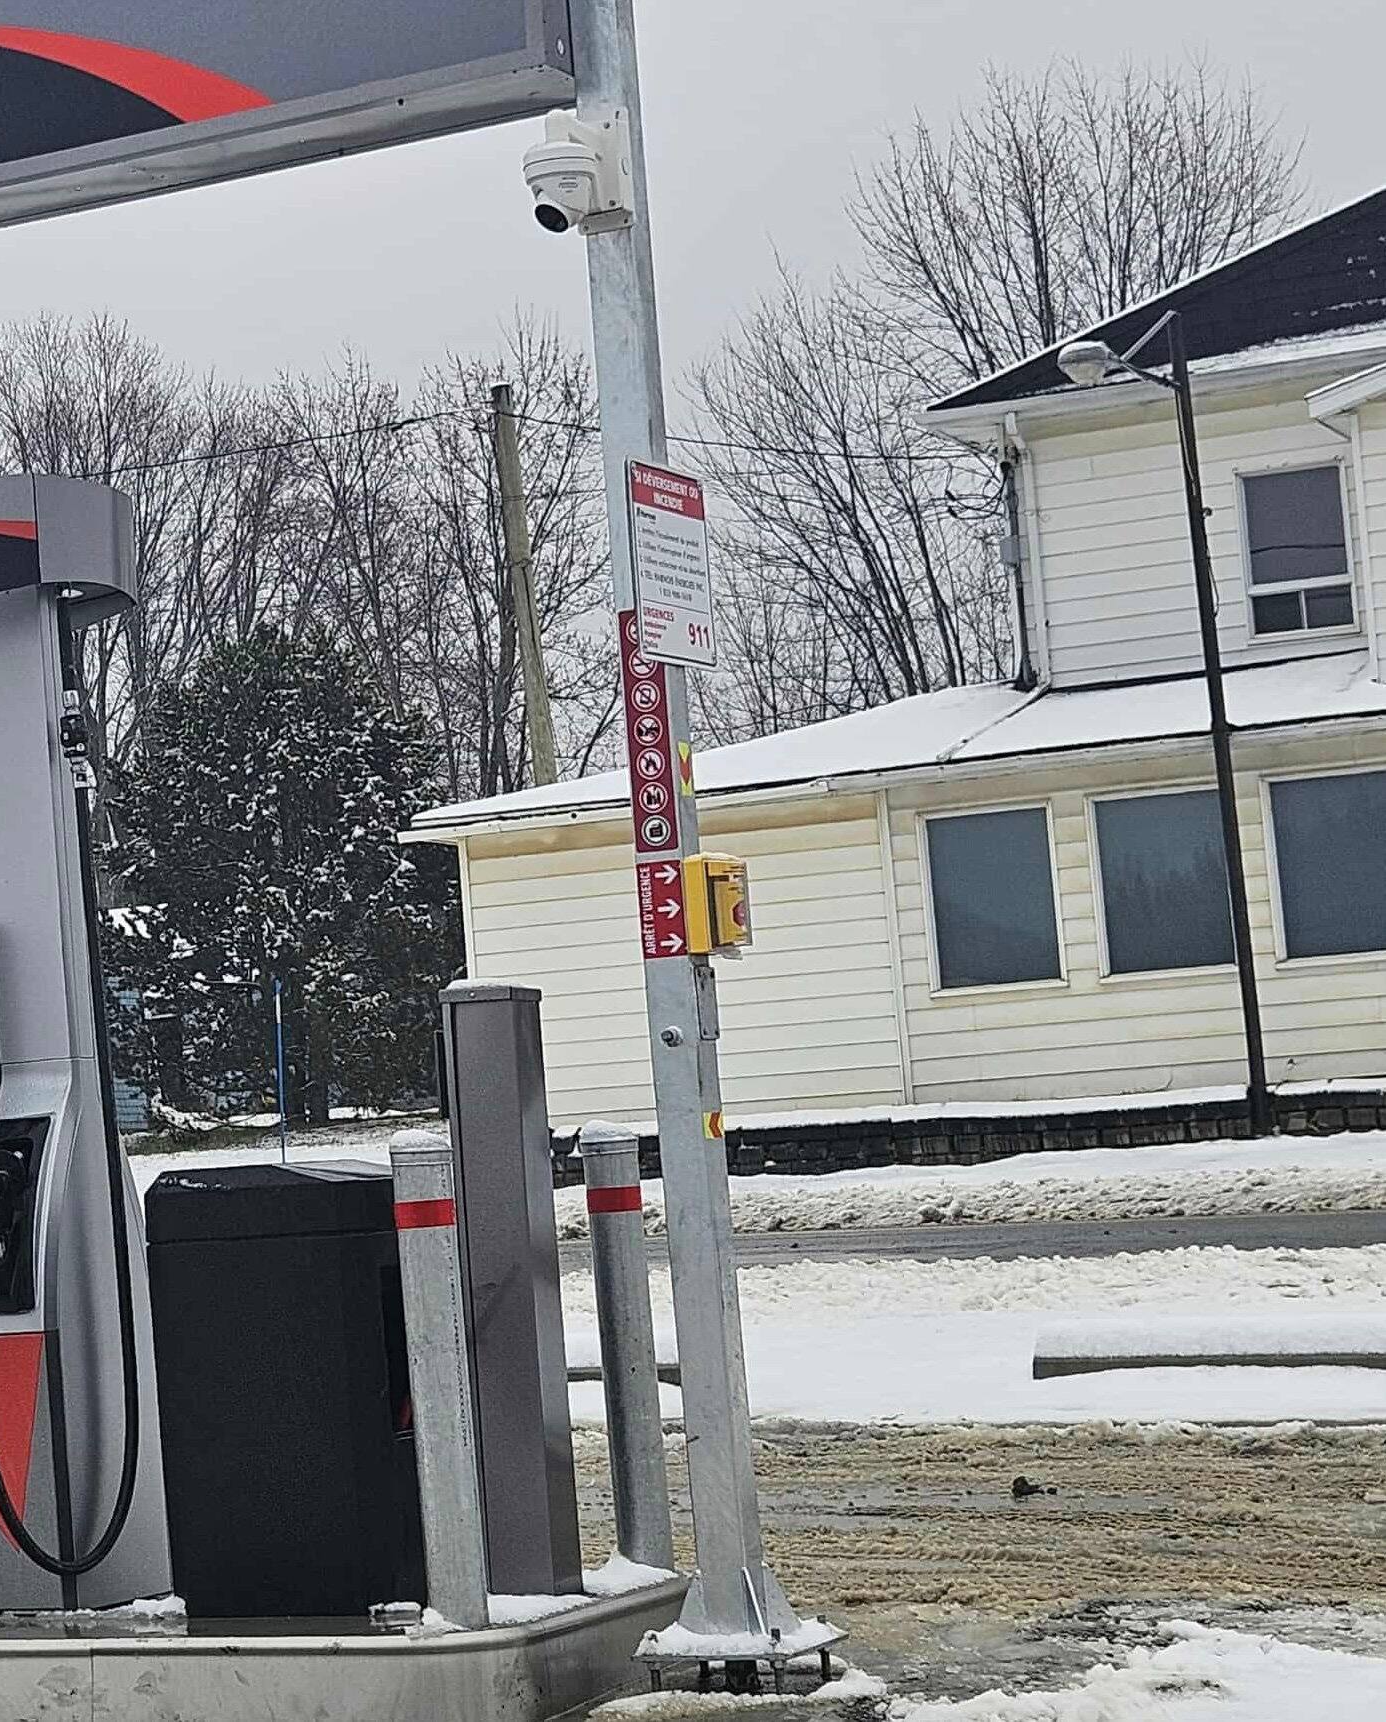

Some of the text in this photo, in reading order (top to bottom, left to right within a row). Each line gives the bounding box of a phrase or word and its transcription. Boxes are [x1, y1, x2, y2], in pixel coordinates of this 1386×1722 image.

[688, 622, 710, 649] 911
[639, 866, 657, 954] ARRÊT D'URGENCE
